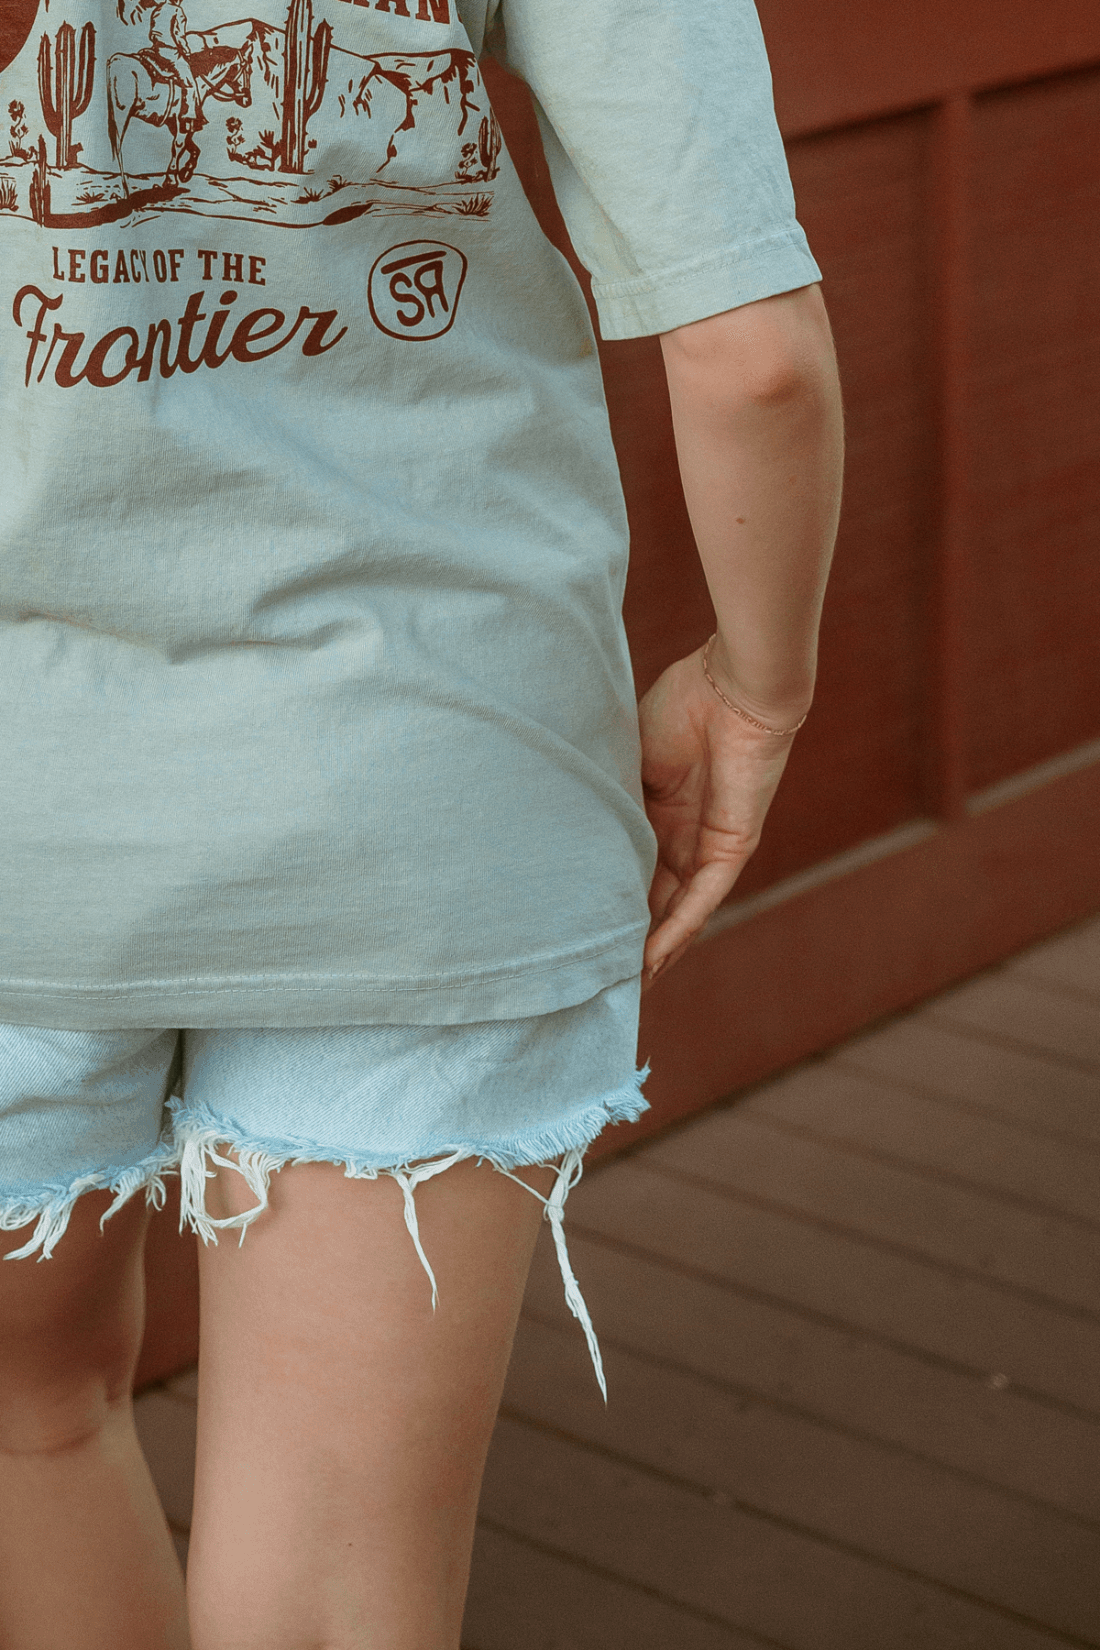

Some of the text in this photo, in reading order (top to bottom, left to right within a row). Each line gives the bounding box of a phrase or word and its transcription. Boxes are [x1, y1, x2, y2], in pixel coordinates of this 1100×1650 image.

[51, 245, 268, 288] LEGACY OF THE
[12, 282, 349, 390] Frontier
